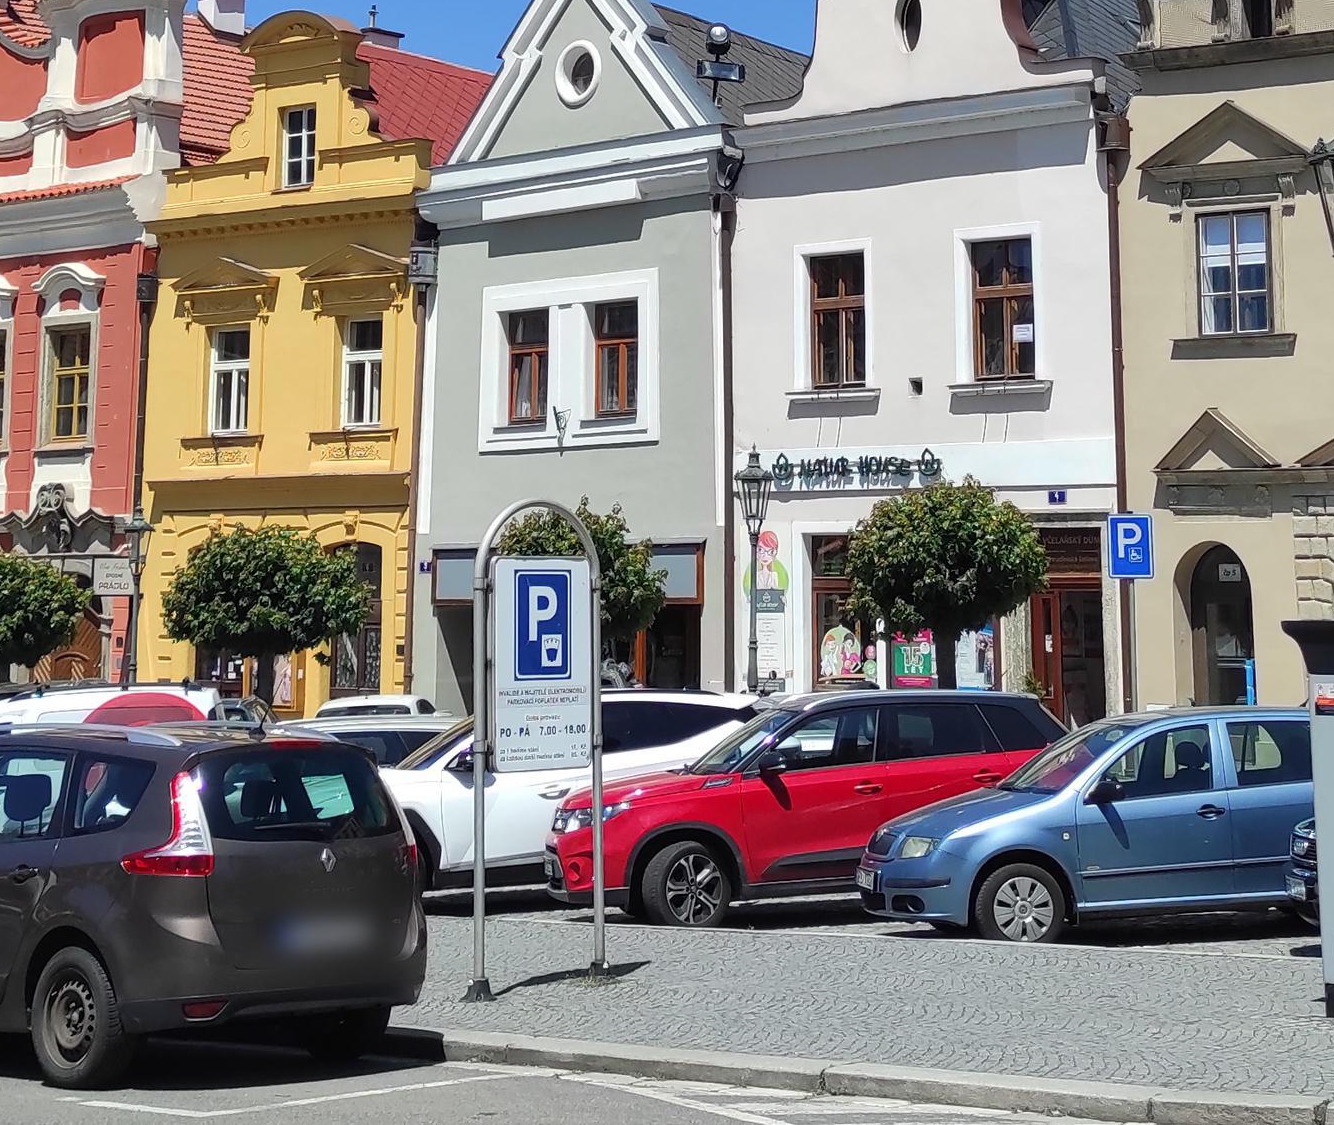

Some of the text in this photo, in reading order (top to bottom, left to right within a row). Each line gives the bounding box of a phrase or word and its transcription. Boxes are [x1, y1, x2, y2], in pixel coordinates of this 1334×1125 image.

[858, 455, 911, 476] HOUSE
[1117, 523, 1142, 558] P
[529, 586, 558, 641] P
[899, 646, 924, 667] 15
[499, 728, 511, 738] PO
[519, 724, 530, 737] PÁ
[539, 726, 557, 736] 7.00
[564, 724, 586, 735] 18.00
